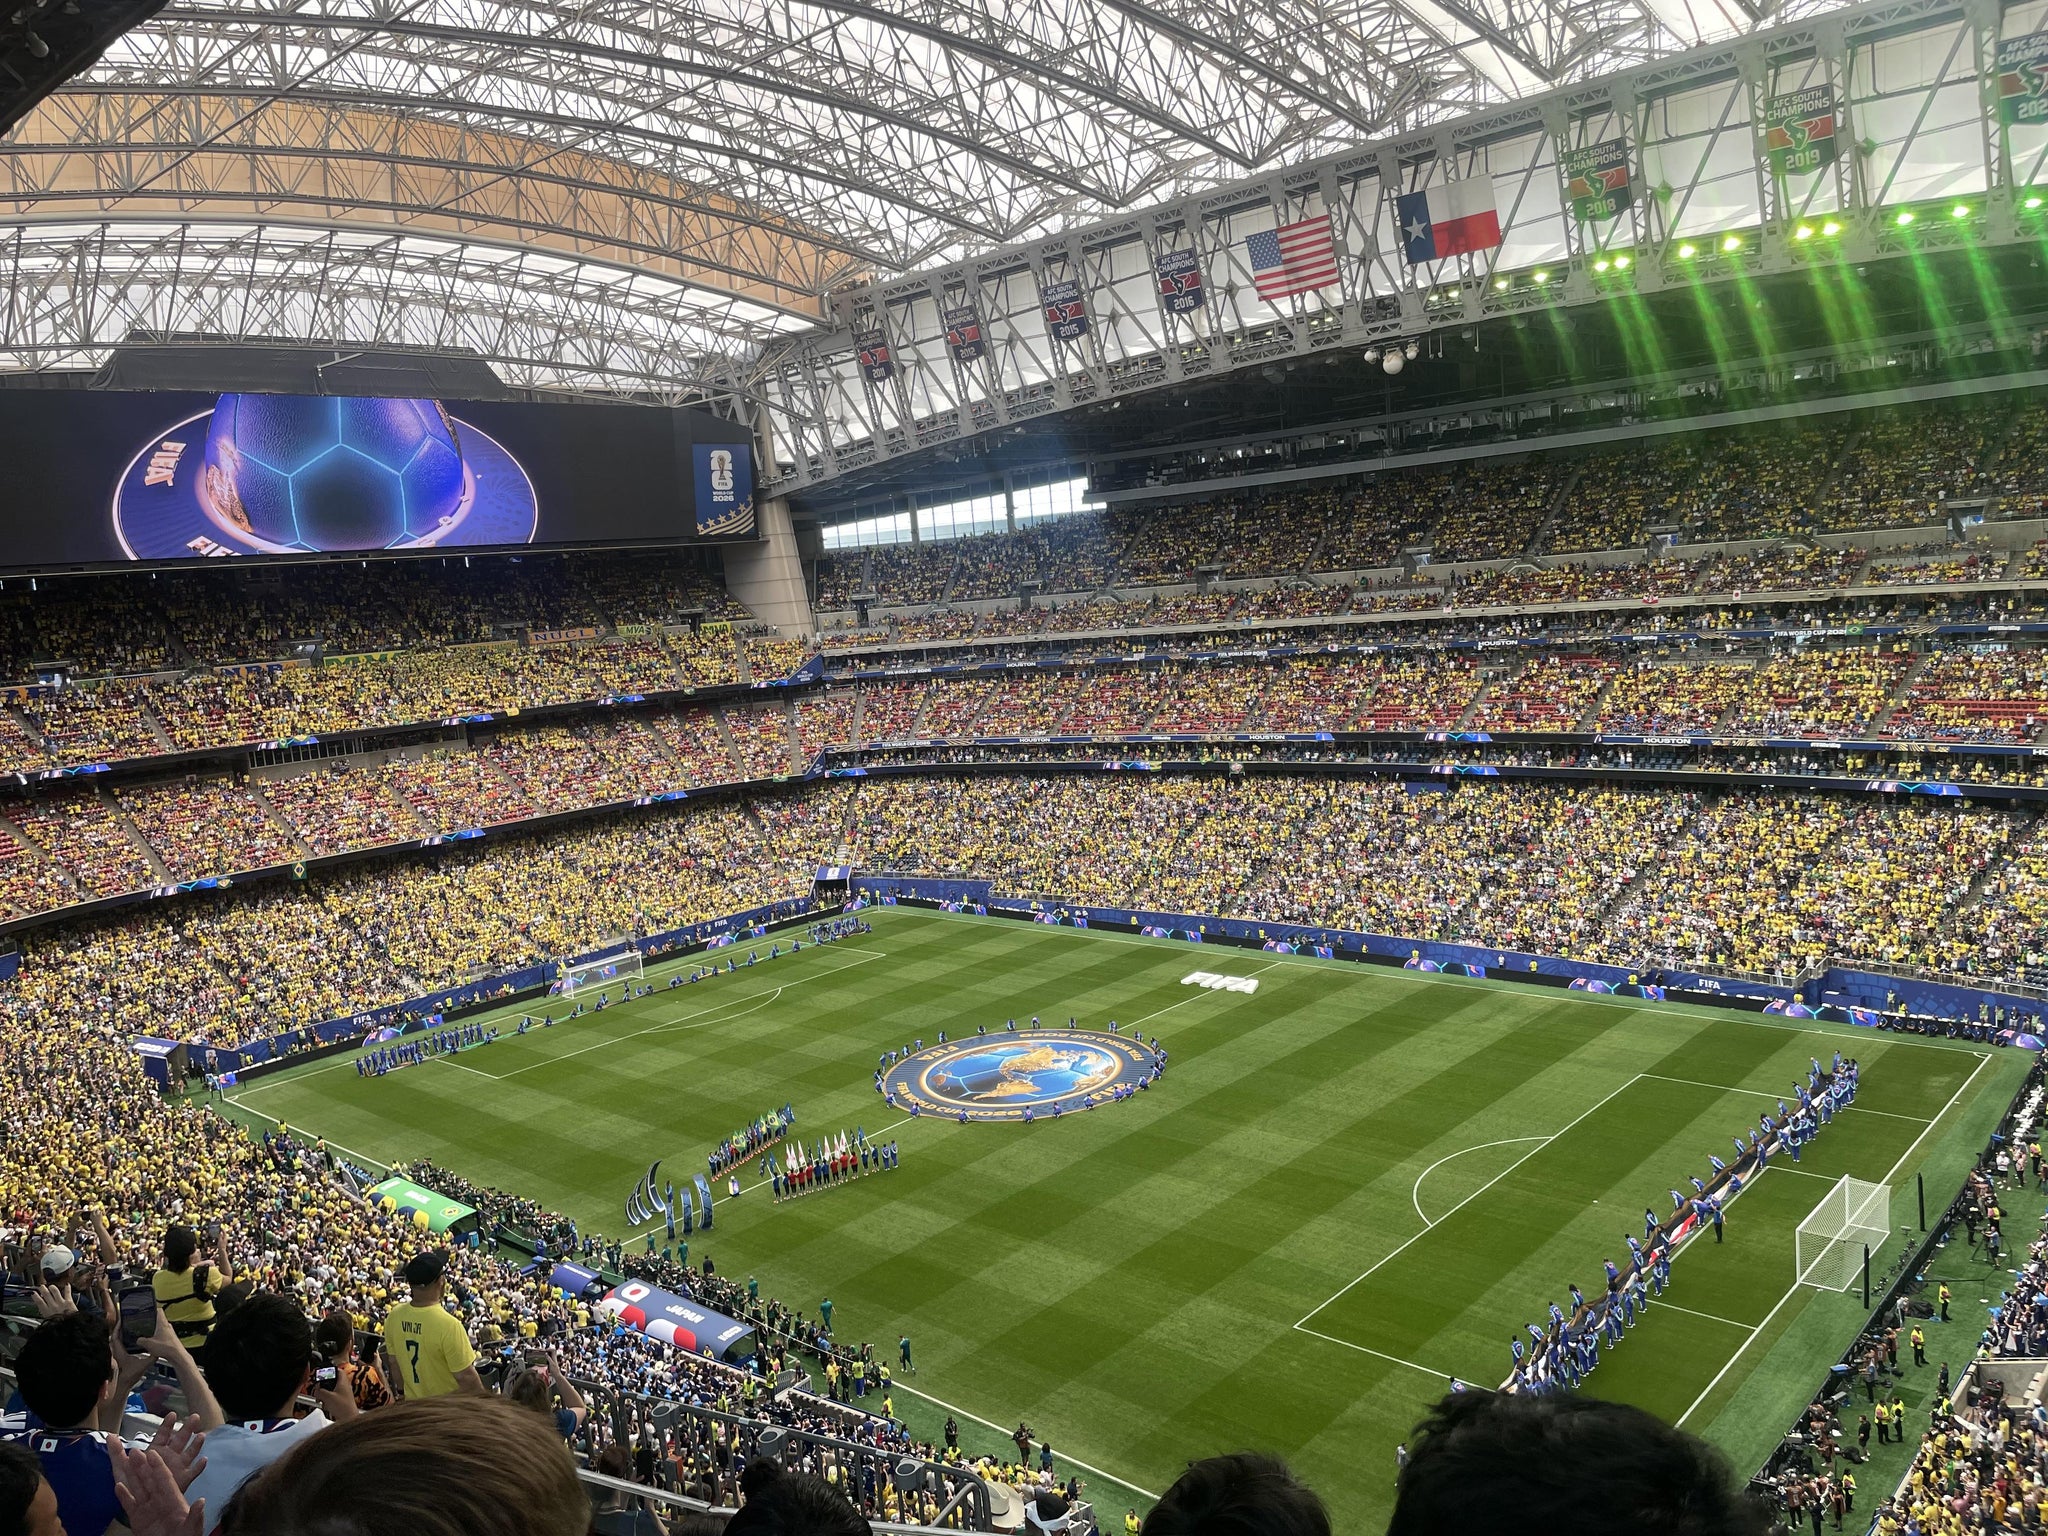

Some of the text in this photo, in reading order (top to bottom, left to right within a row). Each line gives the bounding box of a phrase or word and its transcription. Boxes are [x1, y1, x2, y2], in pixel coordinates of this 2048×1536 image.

[2006, 40, 2027, 53] AFC
[1773, 89, 1822, 109] AFC SOUTH
[1767, 96, 1830, 121] CHAMPIONS
[1573, 143, 1616, 161] AFC SOUTH
[1785, 149, 1820, 170] 2019
[1568, 150, 1623, 172] CHAMPIONS
[1585, 198, 1617, 217] 2018
[1158, 258, 1195, 273] CHAMPIONS
[1161, 252, 1190, 265] AFC SOUTH
[1044, 288, 1078, 303] CHAMPIONS
[1047, 283, 1073, 295] AFC SOUTH
[1173, 295, 1195, 310] 2016
[1059, 323, 1080, 337] 2015
[959, 347, 977, 359] 2012
[144, 441, 187, 487] FIFA
[1478, 639, 1519, 648] HOUSTON
[1642, 737, 1692, 745] HOUSTON
[714, 919, 728, 928] FIFA
[1180, 971, 1260, 995] FIFA
[1698, 978, 1721, 990] FIFA
[352, 1014, 372, 1026] FIFA
[665, 1304, 706, 1324] JAPAN
[405, 1339, 420, 1384] 7
